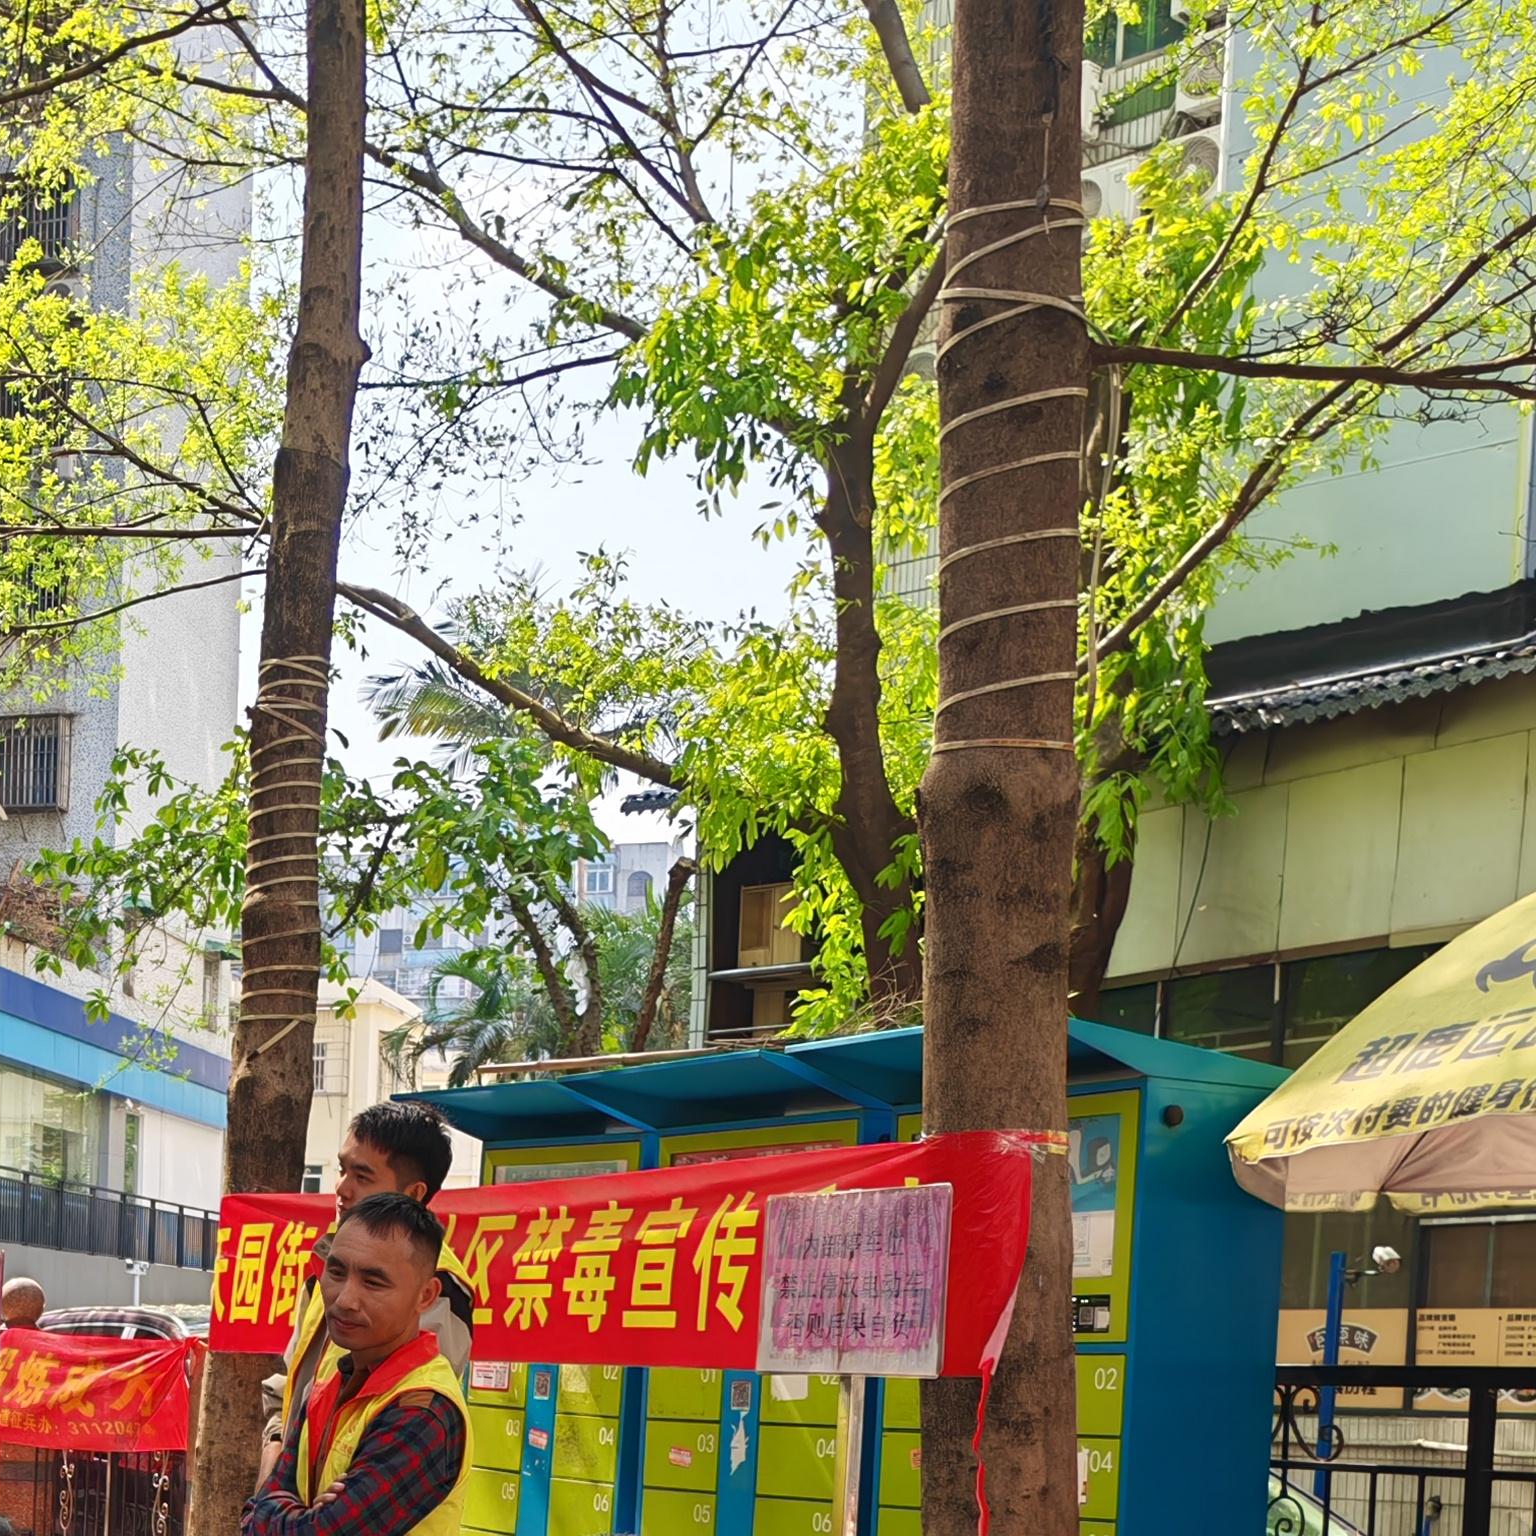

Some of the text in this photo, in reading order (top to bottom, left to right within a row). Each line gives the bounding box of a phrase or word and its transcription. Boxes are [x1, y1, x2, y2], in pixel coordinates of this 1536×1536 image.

[1333, 1006, 1536, 1084] 超鹿运
[446, 1191, 760, 1333] 区禁毒宣传
[779, 1272, 925, 1299] 禁止停放电动车
[786, 1312, 911, 1339] 否则后果自负
[603, 1365, 618, 1380] 02
[1094, 1368, 1117, 1390] 02
[506, 1419, 519, 1436] 03
[599, 1427, 614, 1445] 04
[697, 1434, 714, 1453] 03
[816, 1438, 836, 1458] 04
[1089, 1450, 1113, 1473] 04
[501, 1483, 515, 1500] 05
[593, 1494, 609, 1512] 06
[693, 1504, 710, 1523] 05
[812, 1512, 832, 1533] 06
